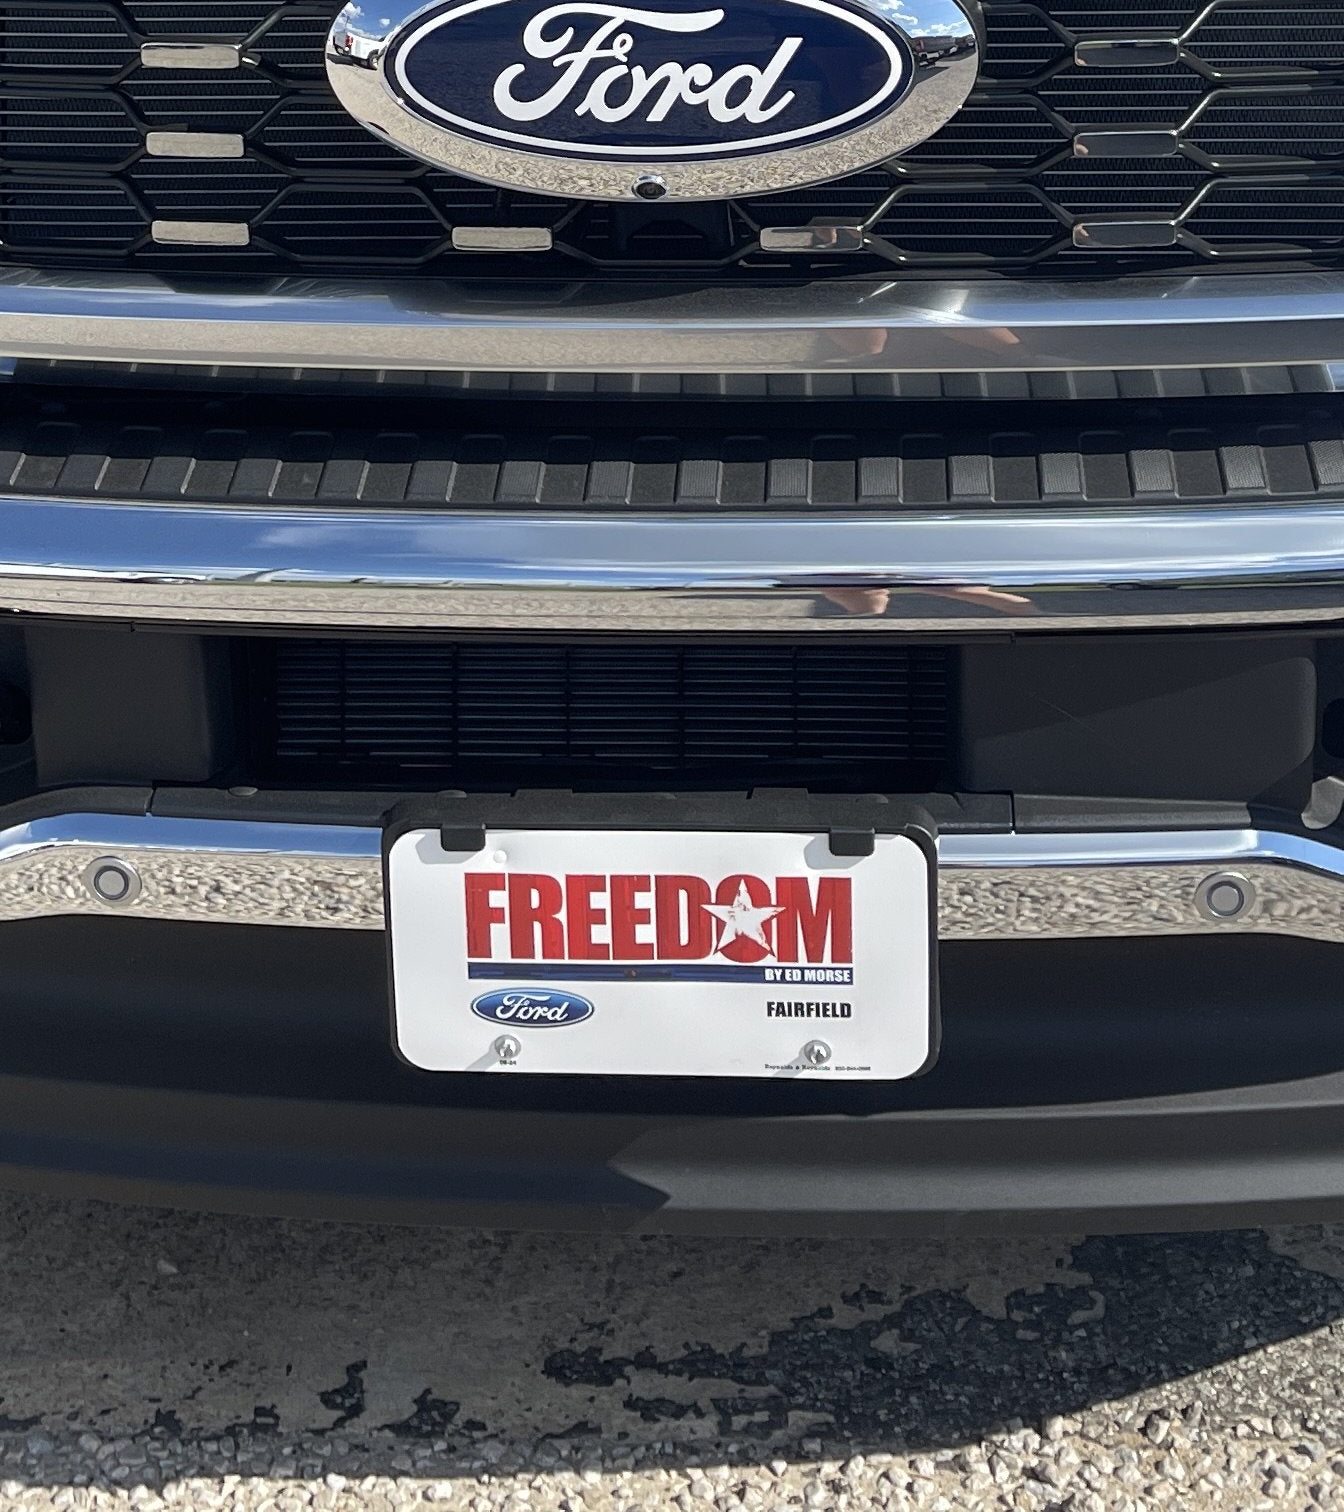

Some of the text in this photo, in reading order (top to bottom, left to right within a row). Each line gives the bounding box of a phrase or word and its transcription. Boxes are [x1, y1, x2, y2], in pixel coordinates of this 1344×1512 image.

[492, 2, 804, 123] Ford
[464, 872, 853, 964] FREEDOM
[764, 968, 851, 983] BY ED MORSE
[495, 993, 570, 1021] Ford
[766, 1001, 852, 1019] FAIRFIELD
